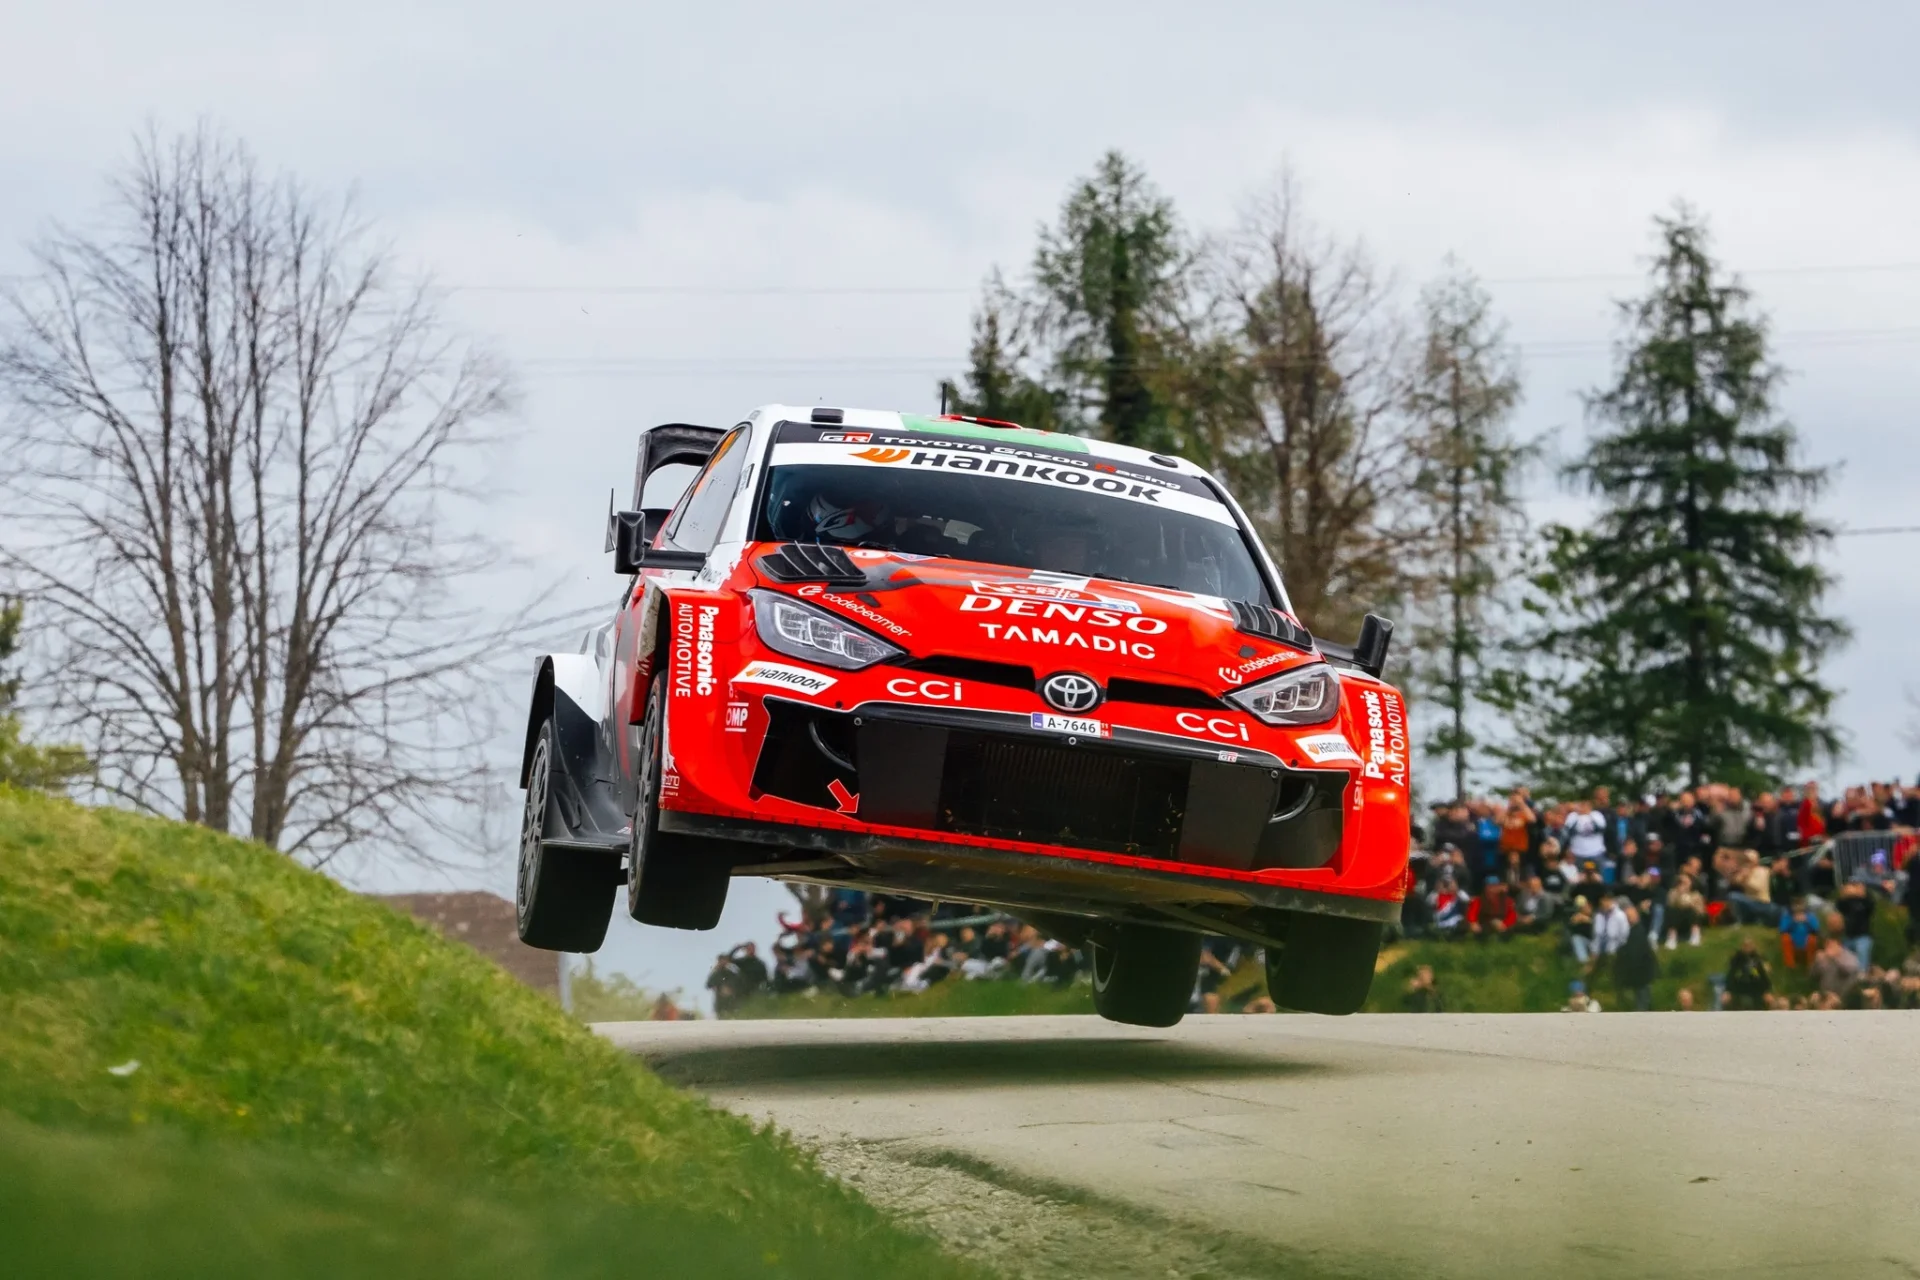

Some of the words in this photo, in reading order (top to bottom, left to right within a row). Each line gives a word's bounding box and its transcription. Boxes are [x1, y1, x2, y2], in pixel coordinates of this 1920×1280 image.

[821, 433, 869, 443] GR
[879, 437, 985, 451] TOYOTA
[991, 447, 1089, 467] GAZOO
[1094, 463, 1181, 490] Racing
[822, 592, 908, 636] codebeamer
[959, 594, 1168, 634] DENSO
[675, 602, 694, 698] AUTOMOTIVE
[696, 605, 719, 697] Panasonic
[979, 623, 1156, 660] TAMADIC
[725, 707, 749, 727] OMP
[1047, 717, 1096, 733] A-7646
[1360, 690, 1386, 779] Panasonic
[1382, 692, 1405, 787] AUTOMOTIVE
